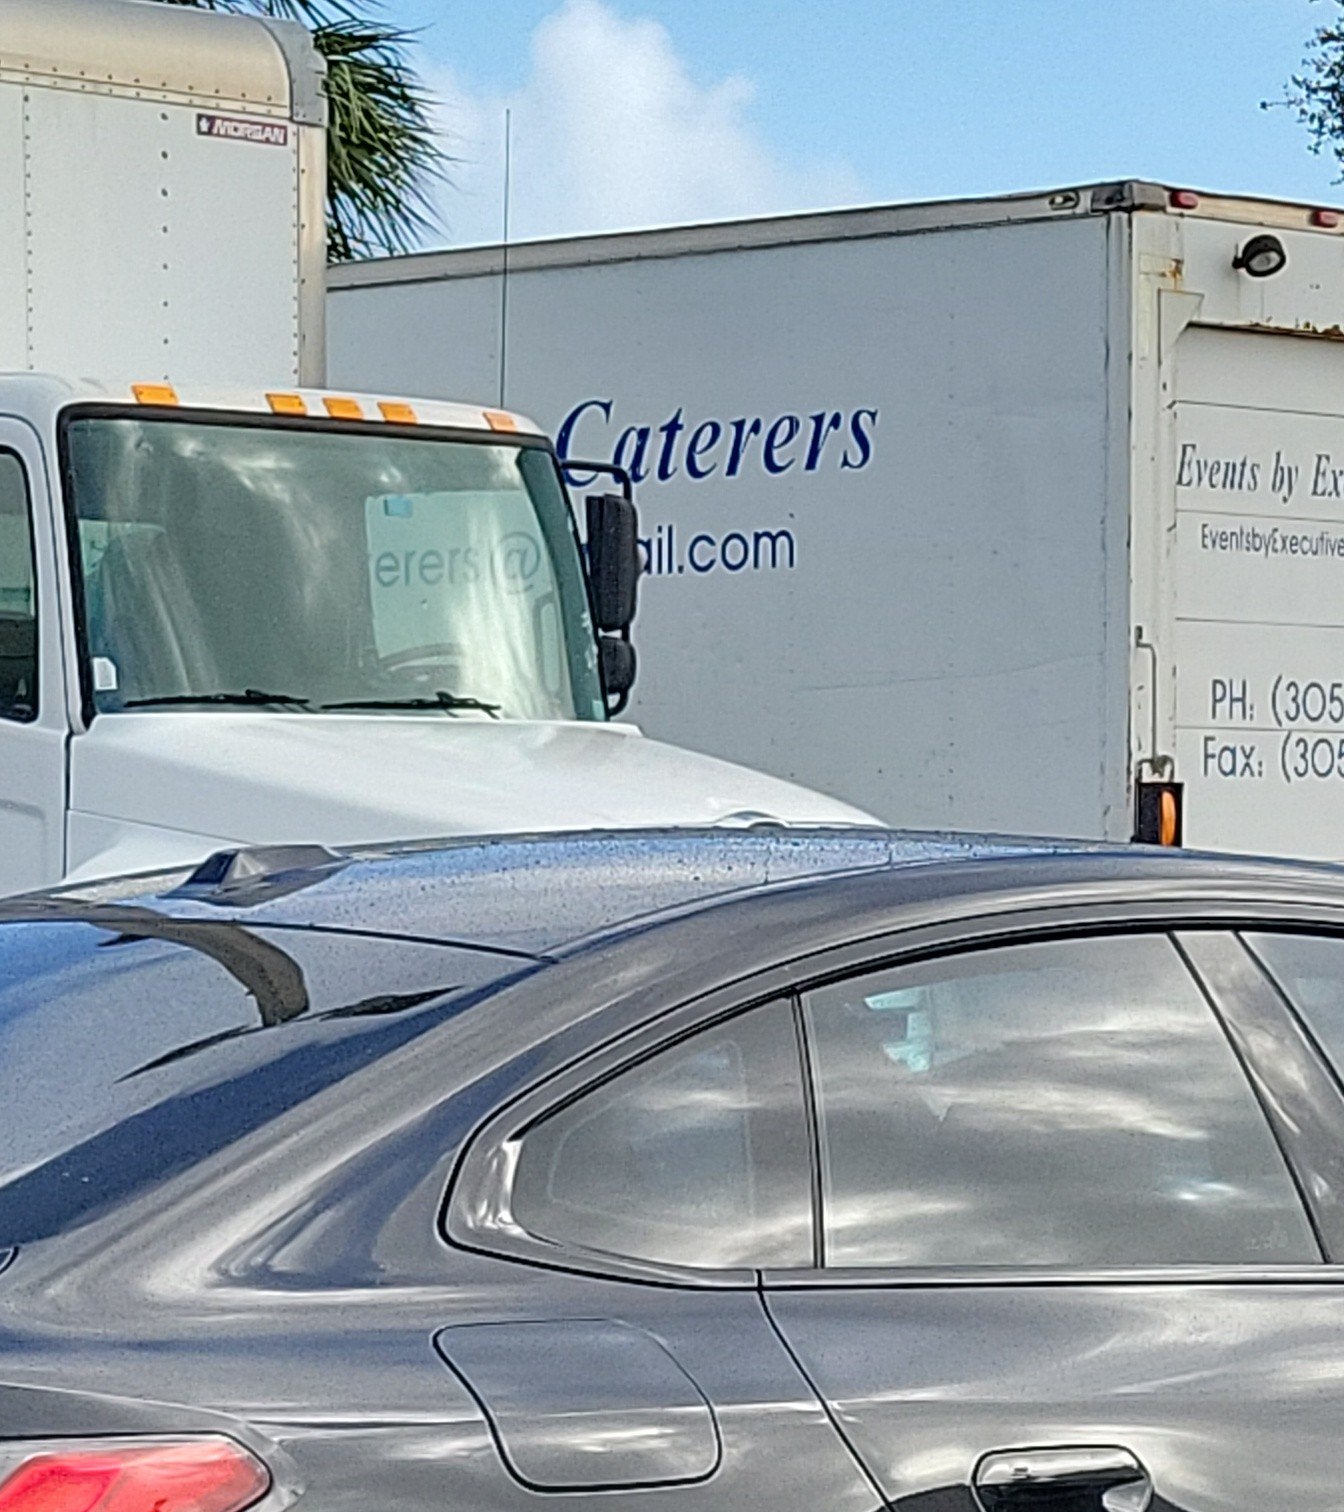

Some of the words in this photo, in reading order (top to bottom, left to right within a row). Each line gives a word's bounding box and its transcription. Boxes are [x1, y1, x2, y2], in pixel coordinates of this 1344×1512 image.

[212, 119, 285, 144] MORGAN
[556, 400, 878, 487] Caterers
[1176, 443, 1261, 492] Events
[1271, 451, 1299, 504] by
[1211, 679, 1254, 721] PH:
[1203, 735, 1263, 778] Fax:
